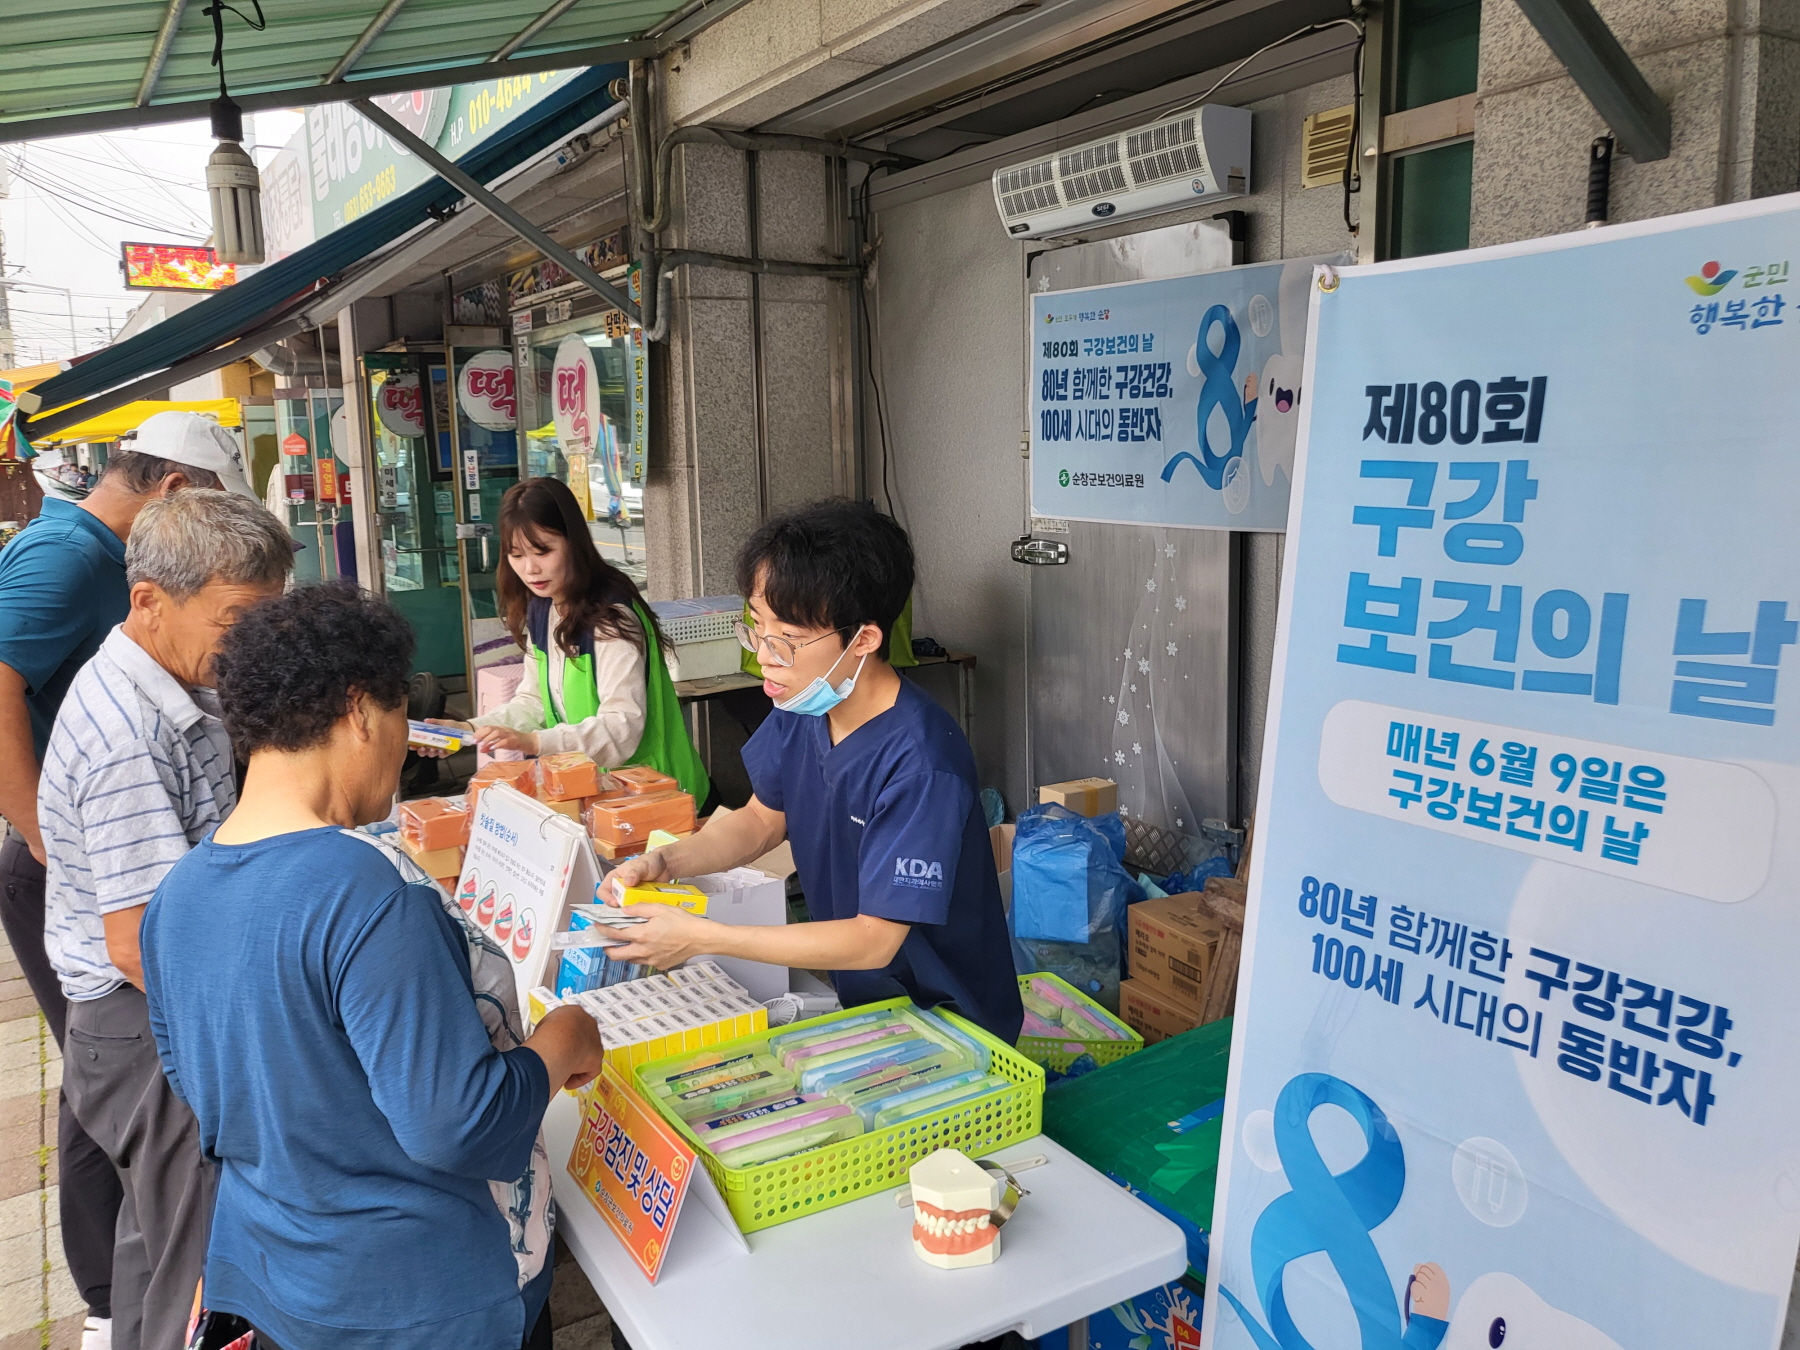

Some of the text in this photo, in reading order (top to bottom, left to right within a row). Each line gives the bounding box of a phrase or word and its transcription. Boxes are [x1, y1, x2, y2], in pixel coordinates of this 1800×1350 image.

[1742, 260, 1789, 289] 군민
[1042, 332, 1155, 359] 제80회 구강보건의 날
[1689, 294, 1787, 335] 행복한
[557, 361, 590, 449] 떡
[1041, 367, 1069, 402] 80년
[1072, 364, 1112, 401] 함께한
[1362, 376, 1548, 446] 제80회
[1040, 406, 1162, 443] 100세 시대의 동반자
[1072, 471, 1145, 488] 순창군보건의료원
[1352, 459, 1539, 567] 구강
[1336, 571, 1799, 727] 보건의 날
[1386, 720, 1668, 816] 매년 6월 9일은
[1388, 768, 1651, 867] 구강보건의 날
[895, 857, 943, 880] KDA
[1298, 873, 1745, 1069] 80년 함께한 구강건강,
[1310, 931, 1719, 1128] 100세 시대의 동반자
[586, 1101, 676, 1232] 구강검진 및 상담
[1176, 1324, 1191, 1341] 04
